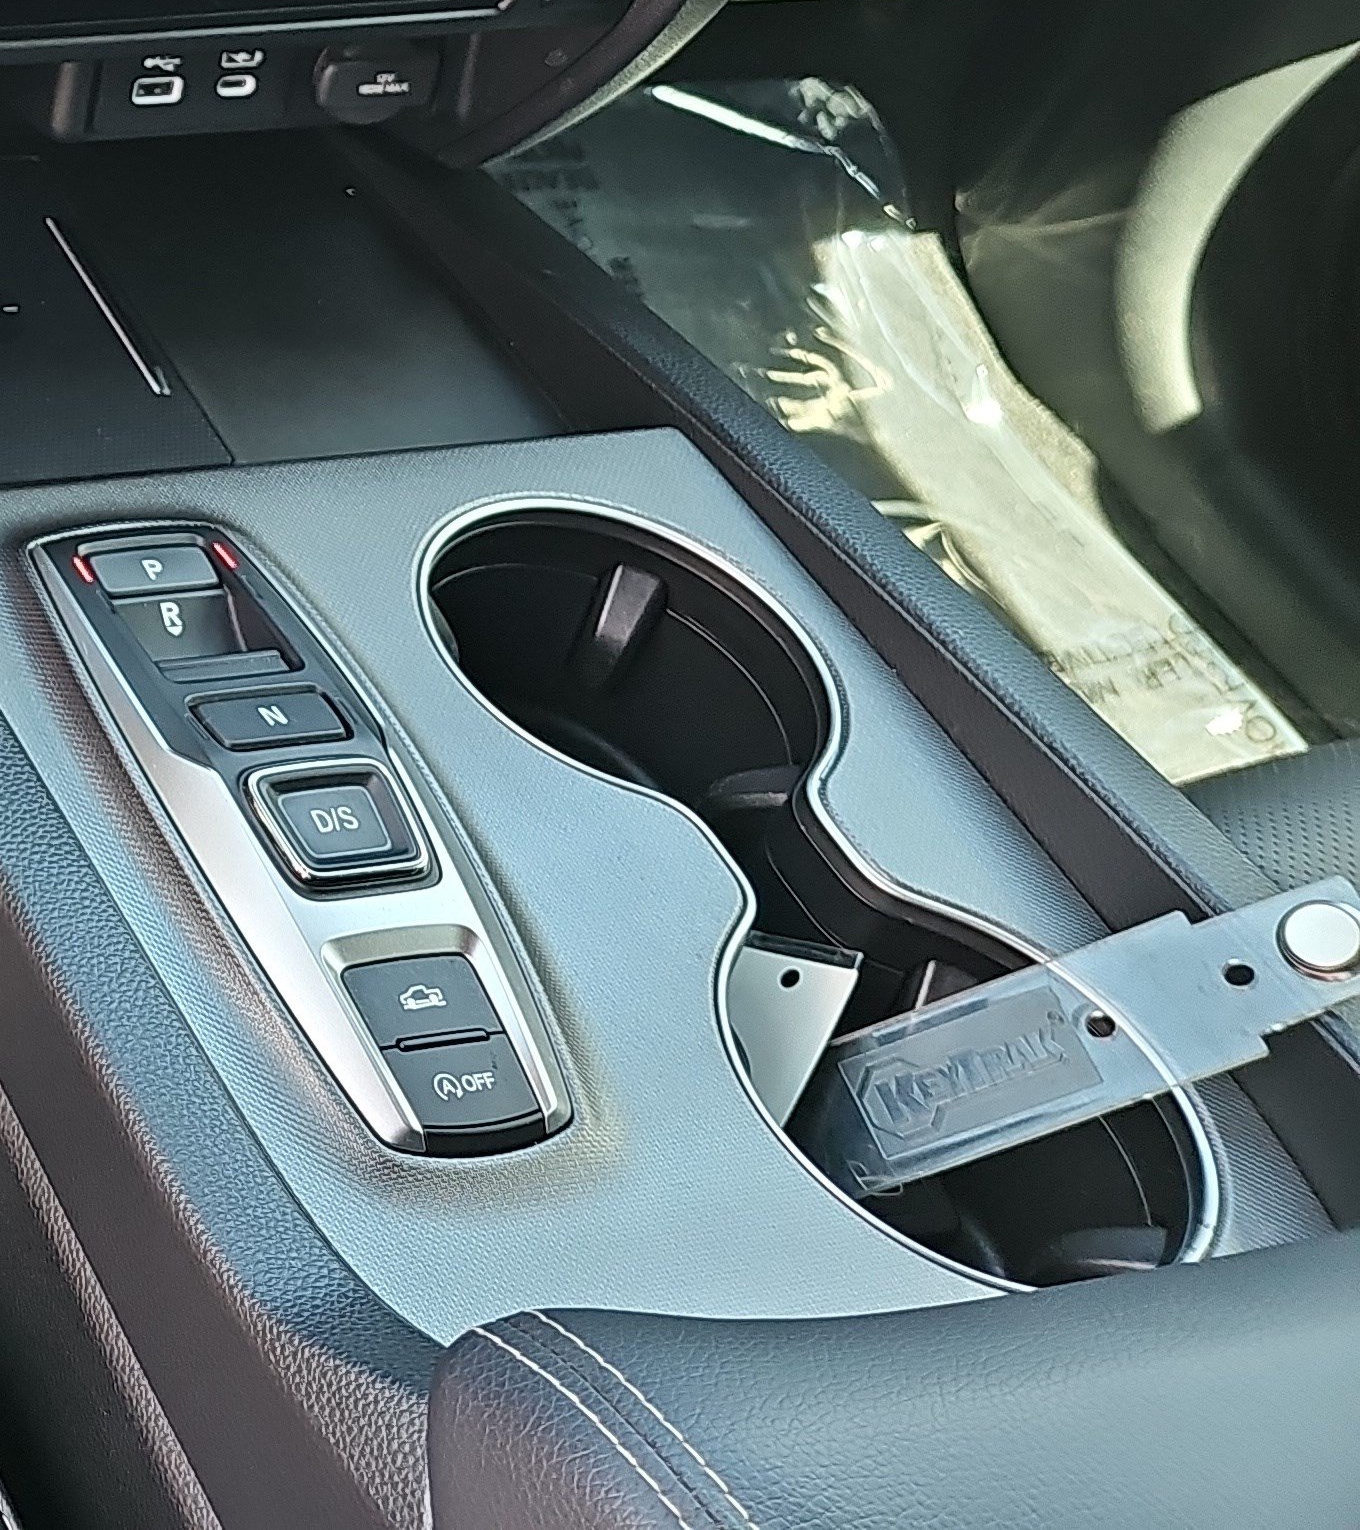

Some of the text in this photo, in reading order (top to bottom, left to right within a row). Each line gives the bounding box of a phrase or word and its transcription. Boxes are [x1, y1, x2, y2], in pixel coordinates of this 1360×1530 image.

[141, 559, 163, 581] P
[160, 602, 182, 627] R
[257, 706, 289, 727] N
[310, 807, 359, 833] D/S
[461, 1072, 495, 1092] OFF
